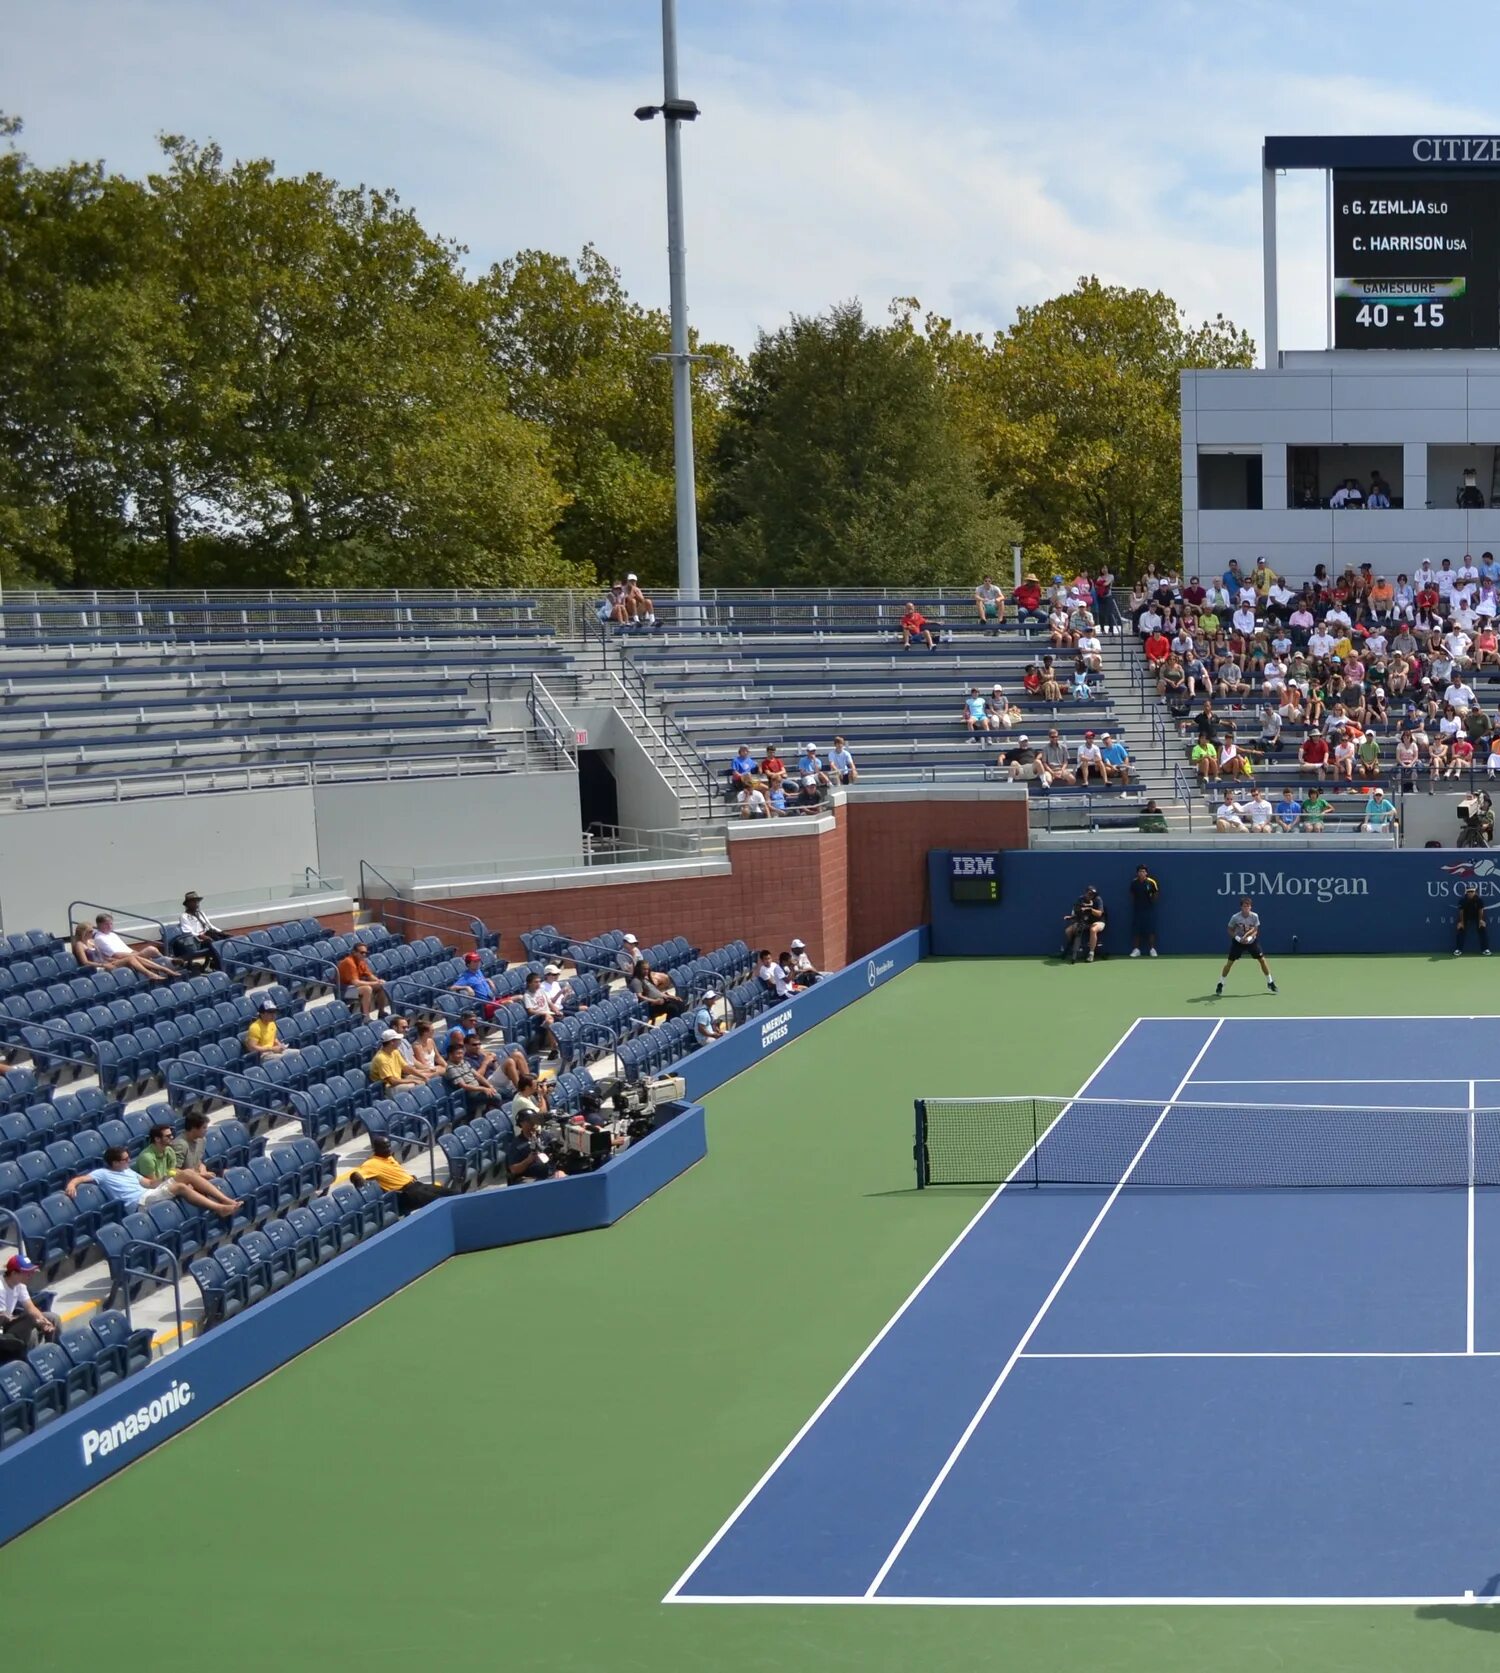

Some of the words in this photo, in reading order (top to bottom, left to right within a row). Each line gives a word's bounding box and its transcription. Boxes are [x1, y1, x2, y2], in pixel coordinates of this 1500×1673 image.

[1342, 204, 1349, 215] 6
[1352, 200, 1366, 215] G.
[1369, 200, 1426, 214] ZEMLJA
[1427, 203, 1448, 214] SLO
[1352, 237, 1366, 251] C.
[1370, 236, 1443, 251] HARRISON
[1446, 239, 1467, 250] USA
[1363, 283, 1436, 294] GAMESCORE
[1355, 304, 1388, 327] 40
[1413, 304, 1444, 327] 15
[953, 857, 995, 875] IBM
[1217, 872, 1369, 903] J.P.Morgan
[1427, 881, 1449, 897] US
[762, 1009, 792, 1036] AMERICAN
[762, 1024, 788, 1048] EXPRESS
[82, 1380, 191, 1466] Panasonic
